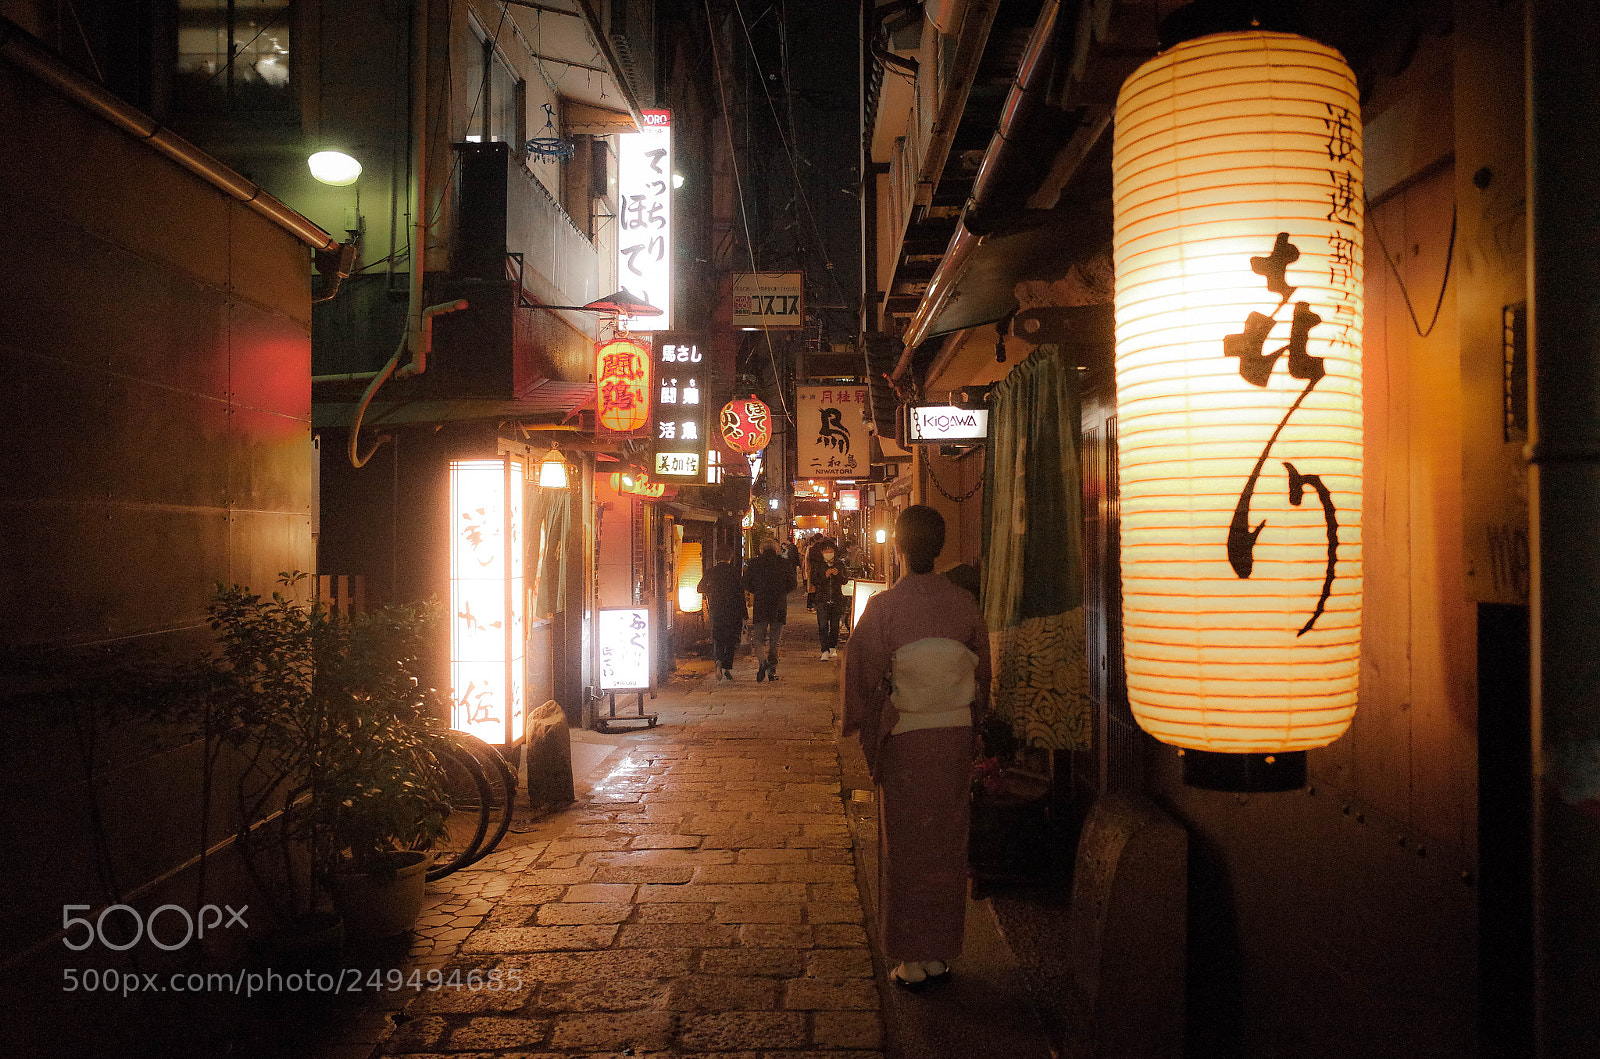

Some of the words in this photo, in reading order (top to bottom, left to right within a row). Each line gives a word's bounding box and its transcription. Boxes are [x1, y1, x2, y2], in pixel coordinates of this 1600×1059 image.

[643, 147, 668, 262] てっちり
[751, 295, 800, 315] コスコス
[661, 344, 702, 363] 馬さし
[820, 390, 865, 404] 月桂冠
[658, 455, 697, 472] 美加佐
